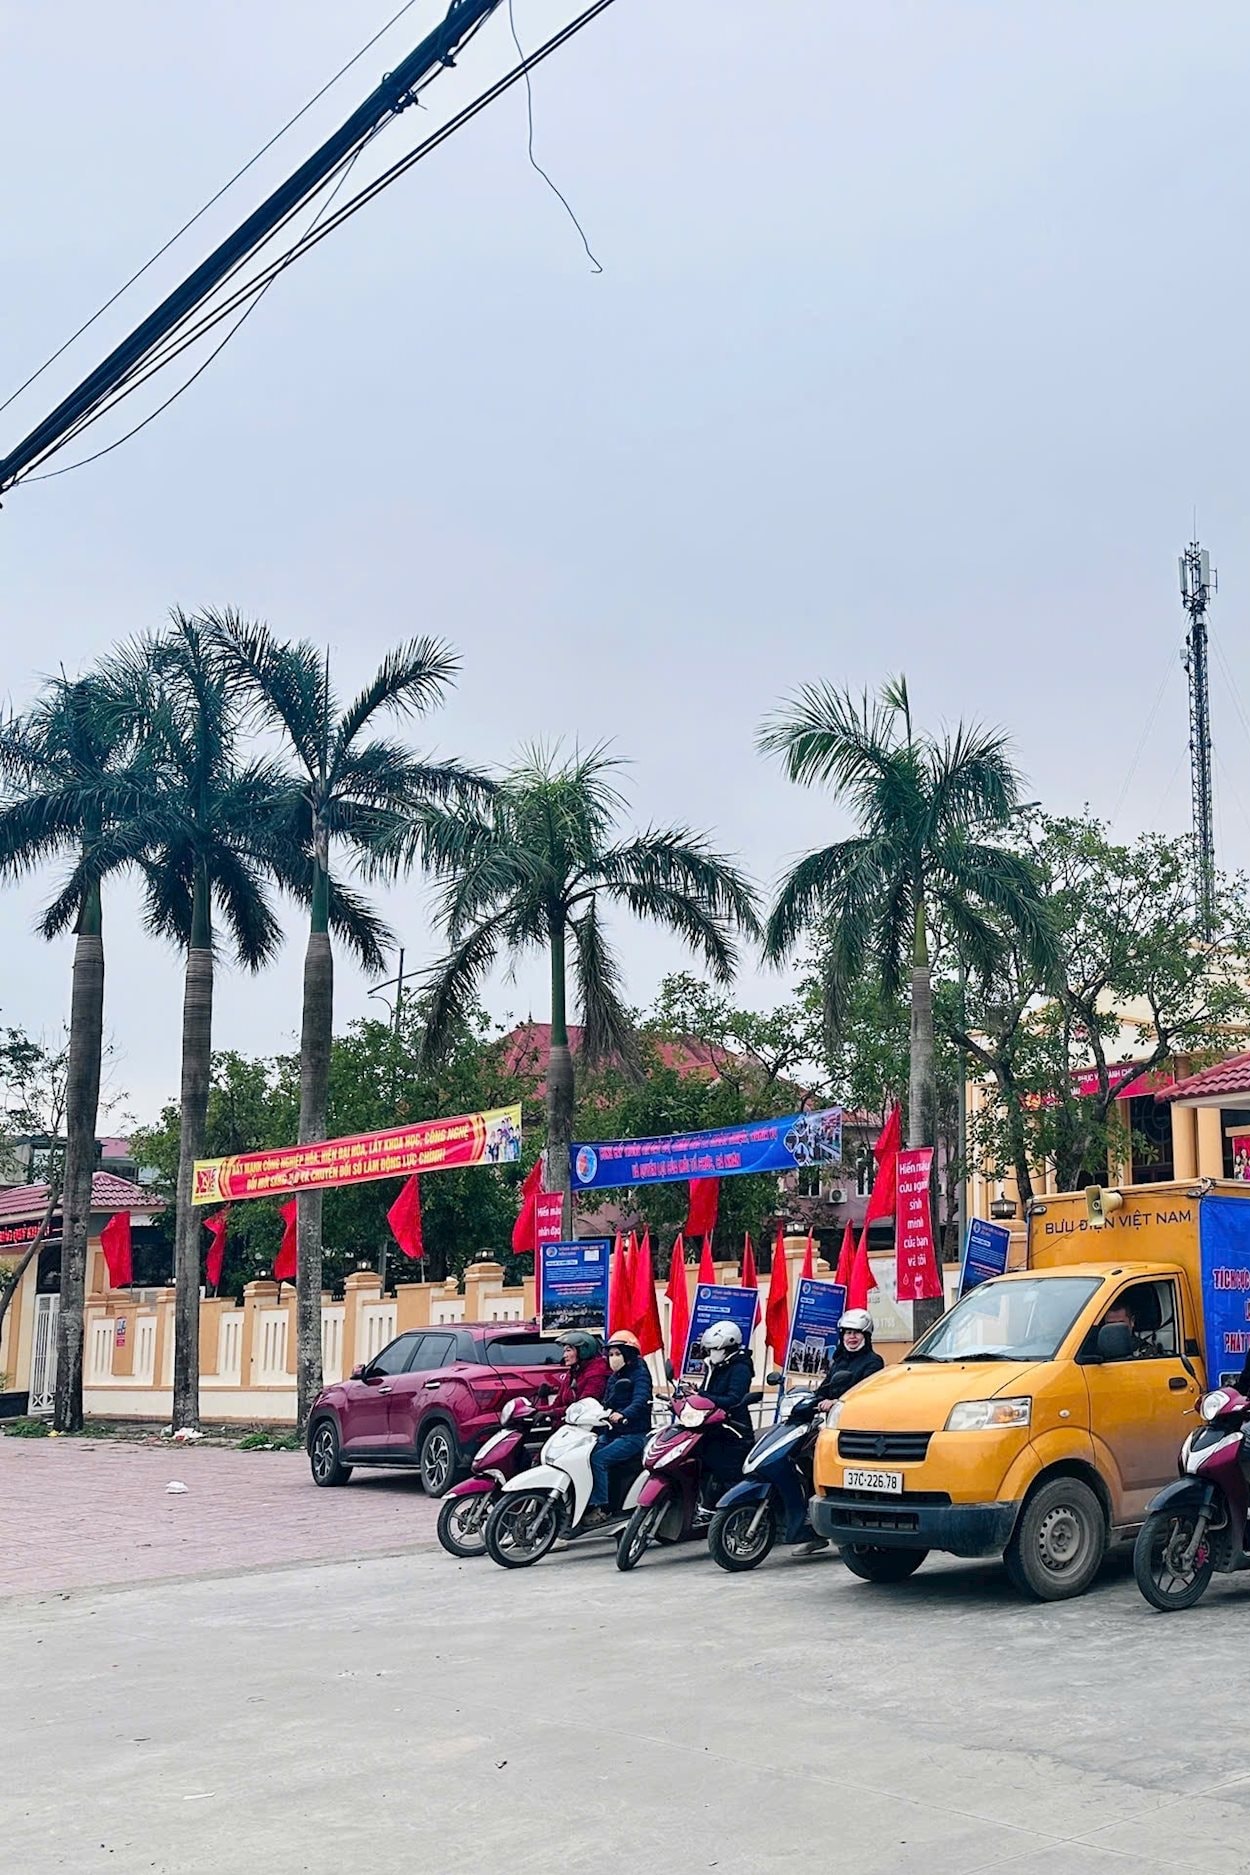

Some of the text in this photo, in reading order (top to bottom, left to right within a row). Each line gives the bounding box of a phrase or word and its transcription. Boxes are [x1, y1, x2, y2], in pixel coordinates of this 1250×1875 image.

[899, 1160, 916, 1175] Hiến
[1080, 1218, 1115, 1234] ĐN
[1119, 1209, 1152, 1230] VIỆT
[1156, 1210, 1191, 1225] NAM
[1223, 1329, 1246, 1353] PHÁT
